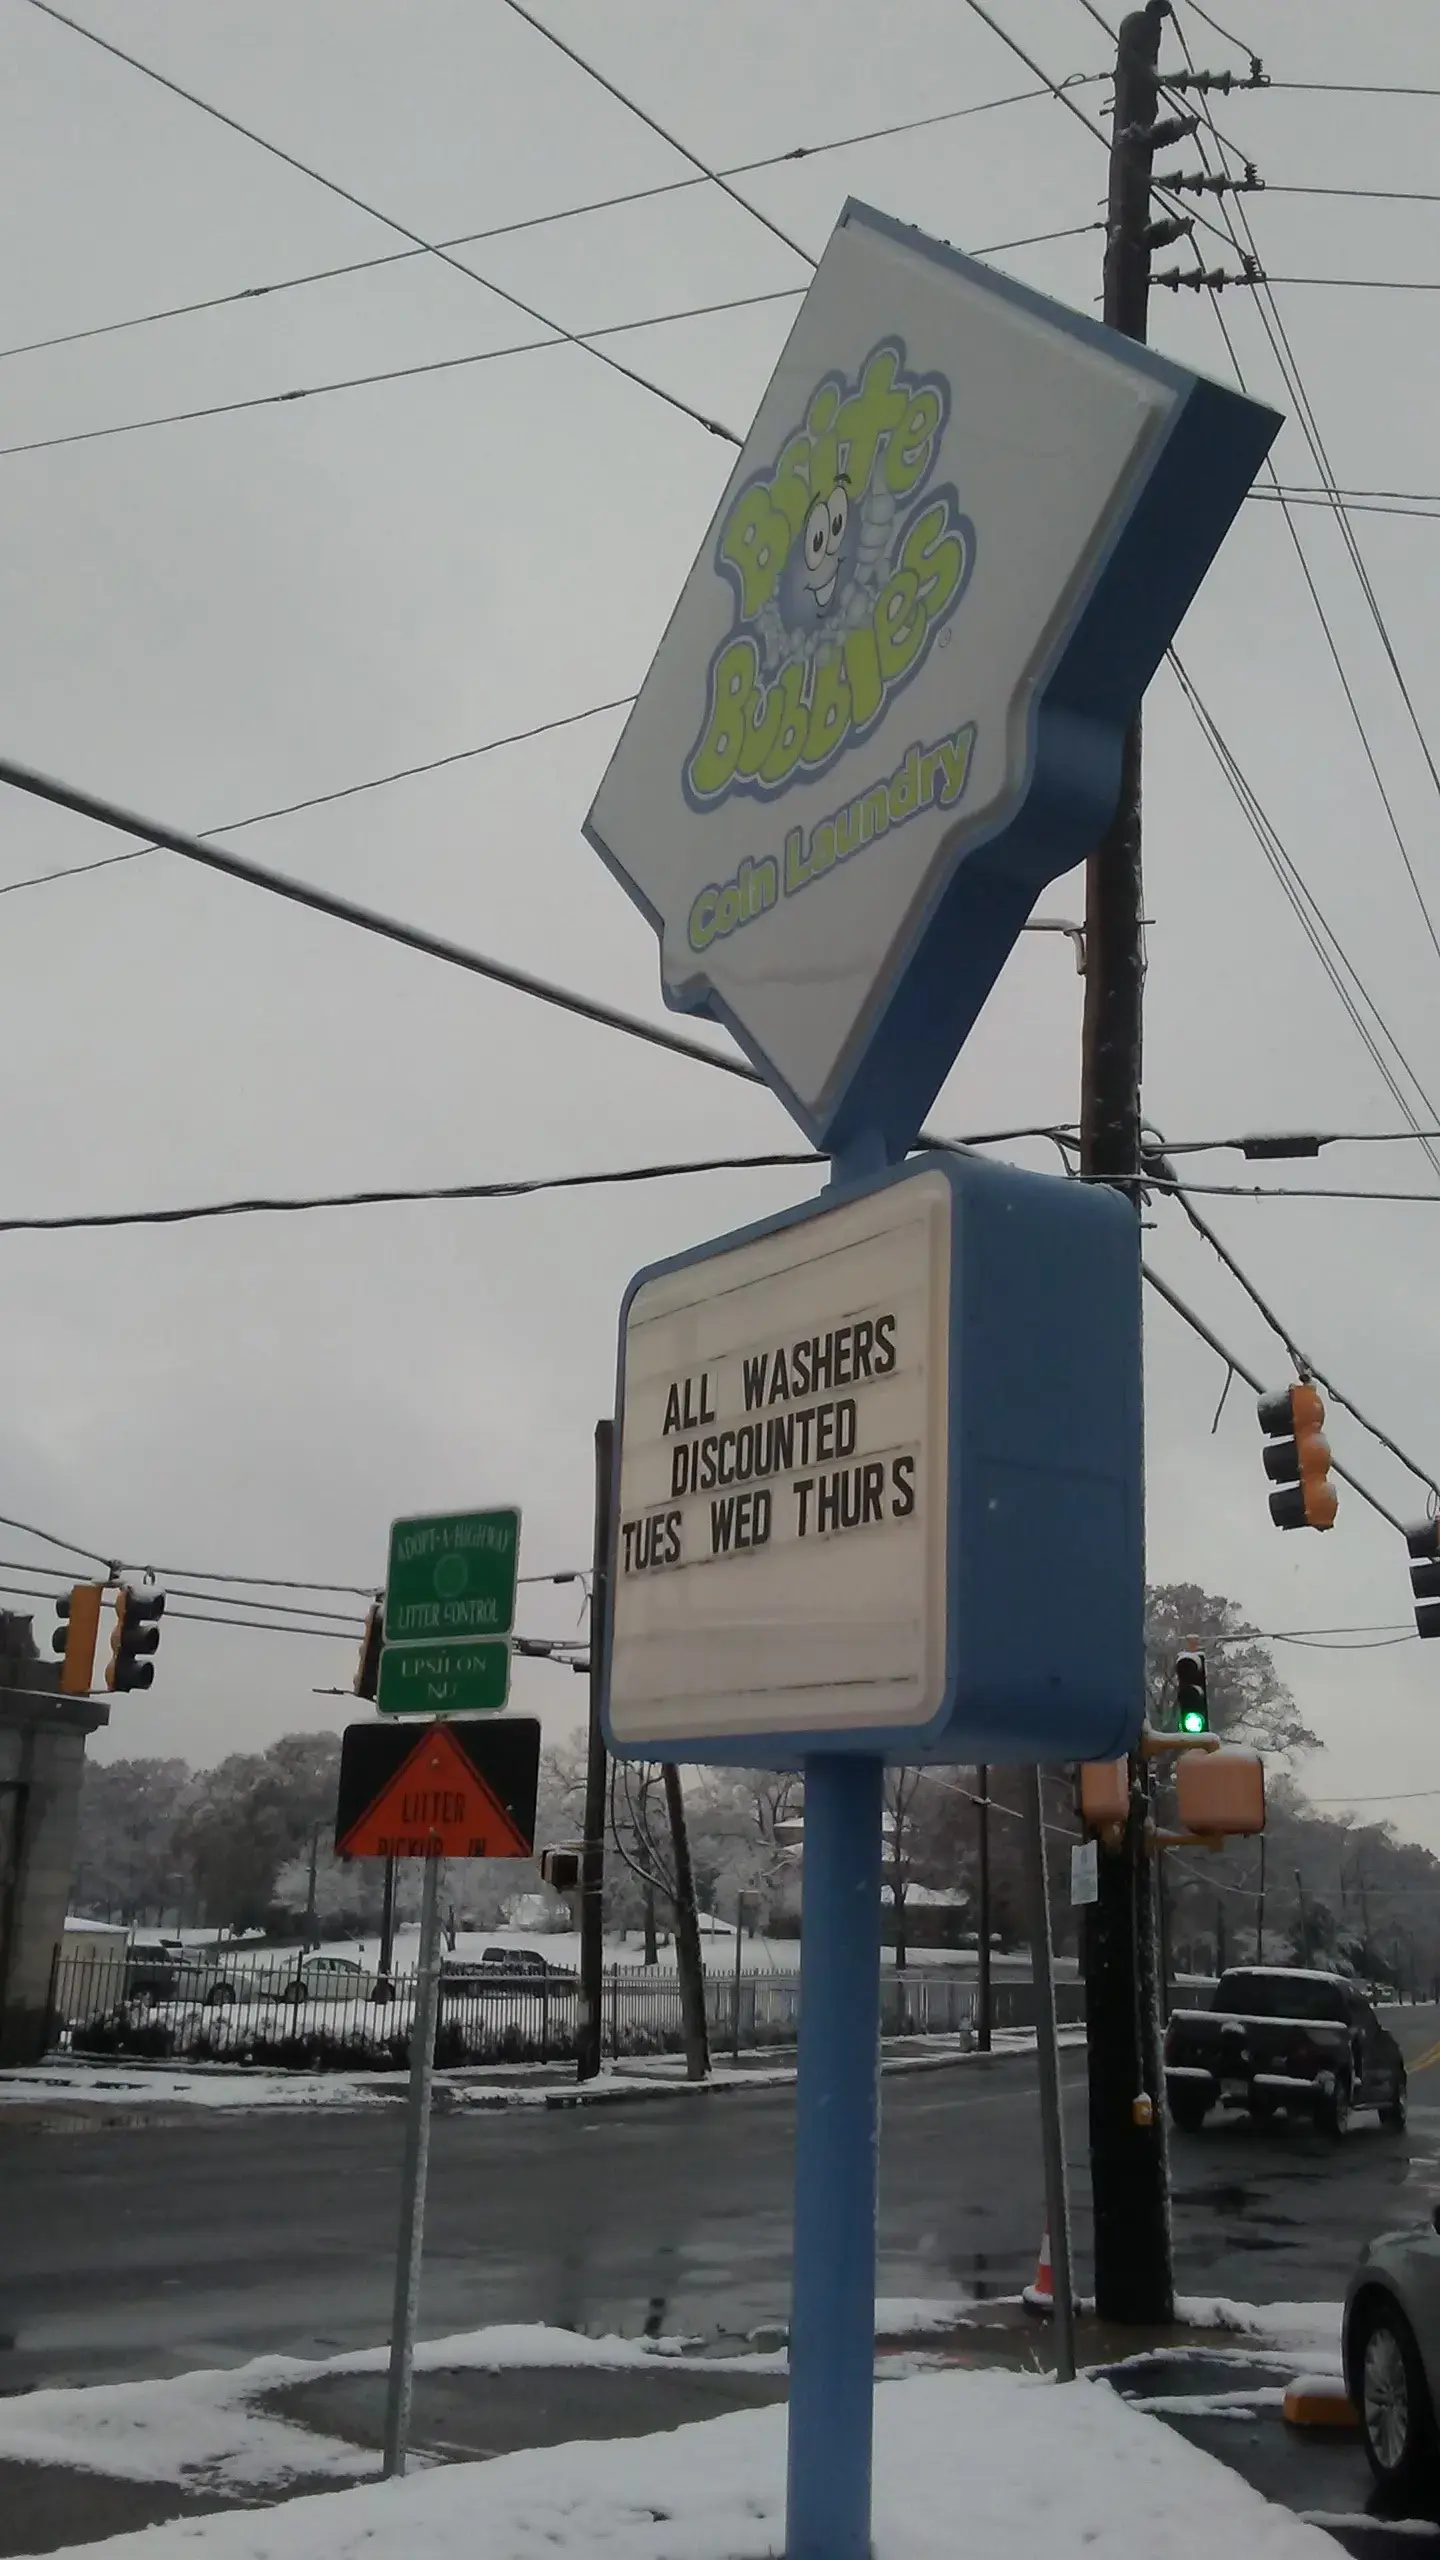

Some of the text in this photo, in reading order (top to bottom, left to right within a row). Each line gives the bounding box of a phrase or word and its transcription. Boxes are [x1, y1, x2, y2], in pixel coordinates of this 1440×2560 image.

[719, 341, 946, 623] Brite
[686, 495, 969, 802] Bubbles
[690, 725, 973, 949] Coin Laundry
[662, 1313, 896, 1436] ALL WASHERS
[670, 1398, 857, 1498] DISCOUNTED
[622, 1455, 916, 1574] TUES WED THURS
[398, 1598, 499, 1629] LITTER CONTROL
[402, 1656, 487, 1677] EPSILON
[402, 1790, 466, 1824] LITTER
